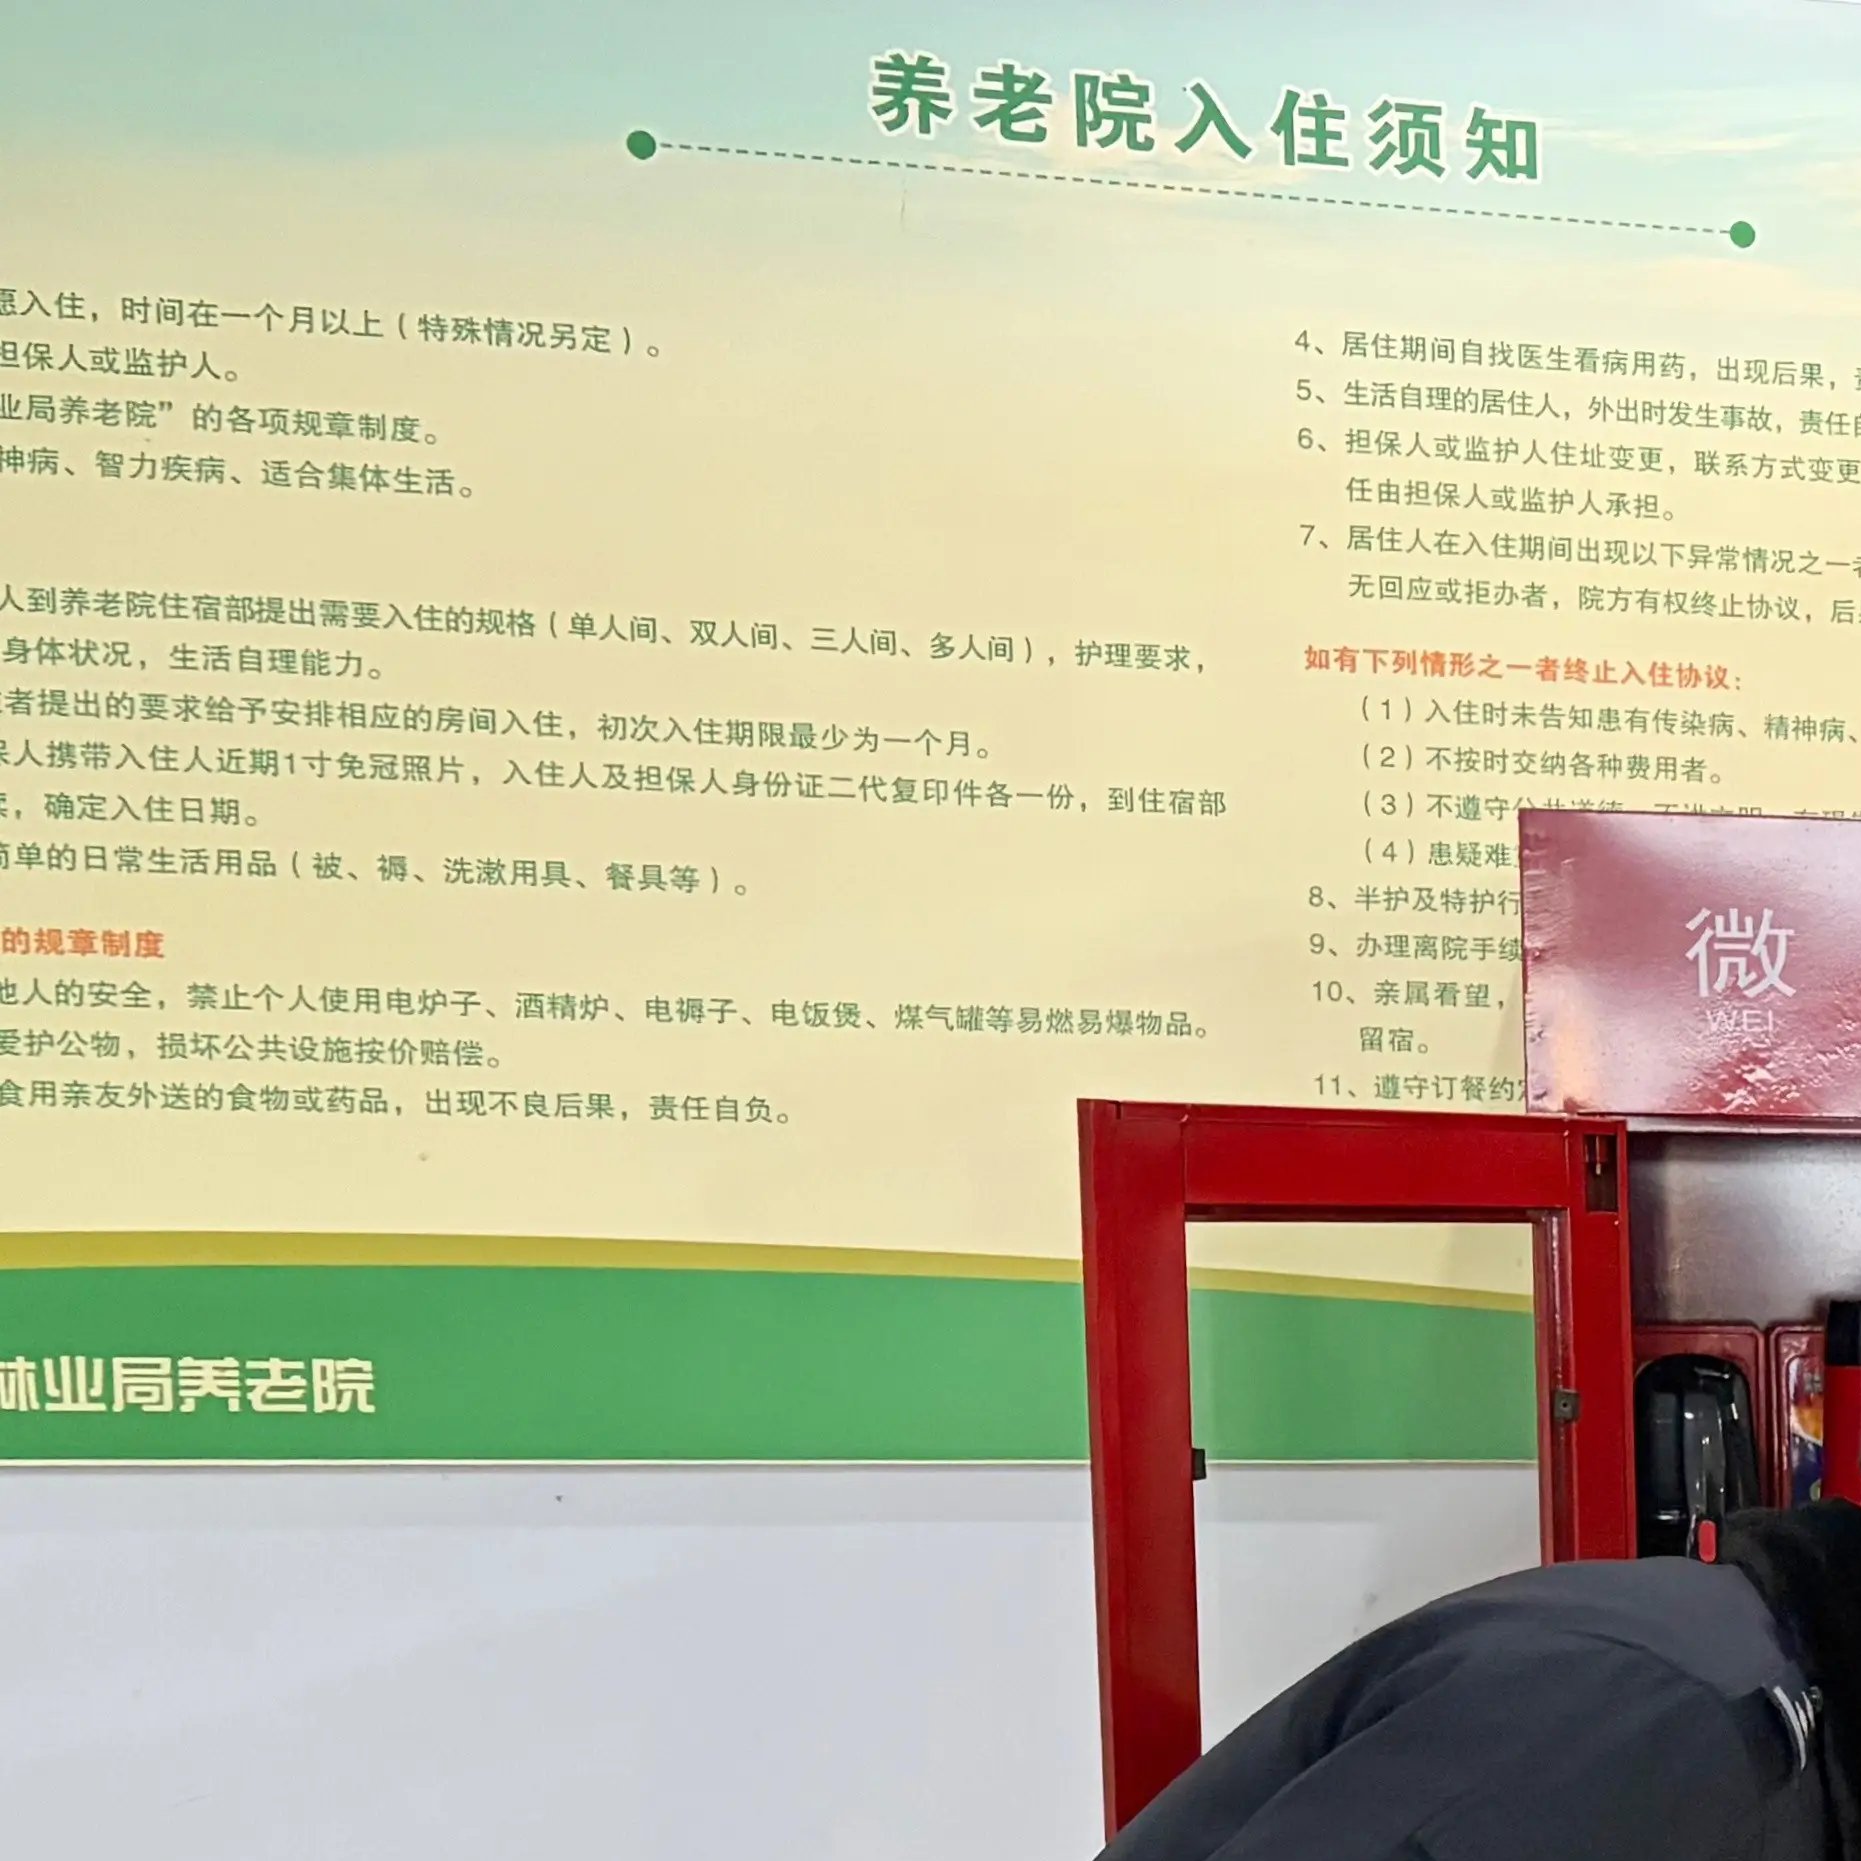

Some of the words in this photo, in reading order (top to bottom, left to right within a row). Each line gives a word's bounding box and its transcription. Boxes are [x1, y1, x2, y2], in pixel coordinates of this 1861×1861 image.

[870, 53, 1540, 181] 养老院入住须知
[1346, 477, 1674, 521] 任由担保人或监护人承担。
[2, 635, 382, 681] 身体状况，生活自理能力。
[1303, 645, 1741, 692] 如有下列情形之一者终止入住协议：
[0, 686, 989, 760] 者提出的要求给予安排相应的房间入住，初次入住期限最少为一个月。
[0, 791, 258, 828] ，确定入住日期。
[1365, 838, 1519, 869] （4）患疑难
[1, 926, 165, 959] 的规章制度
[1312, 978, 1505, 1010] 10、亲属看望，
[1359, 1026, 1428, 1054] 留宿。
[1706, 1009, 1774, 1032] WEI
[0, 1355, 376, 1413] 林业局养老院
